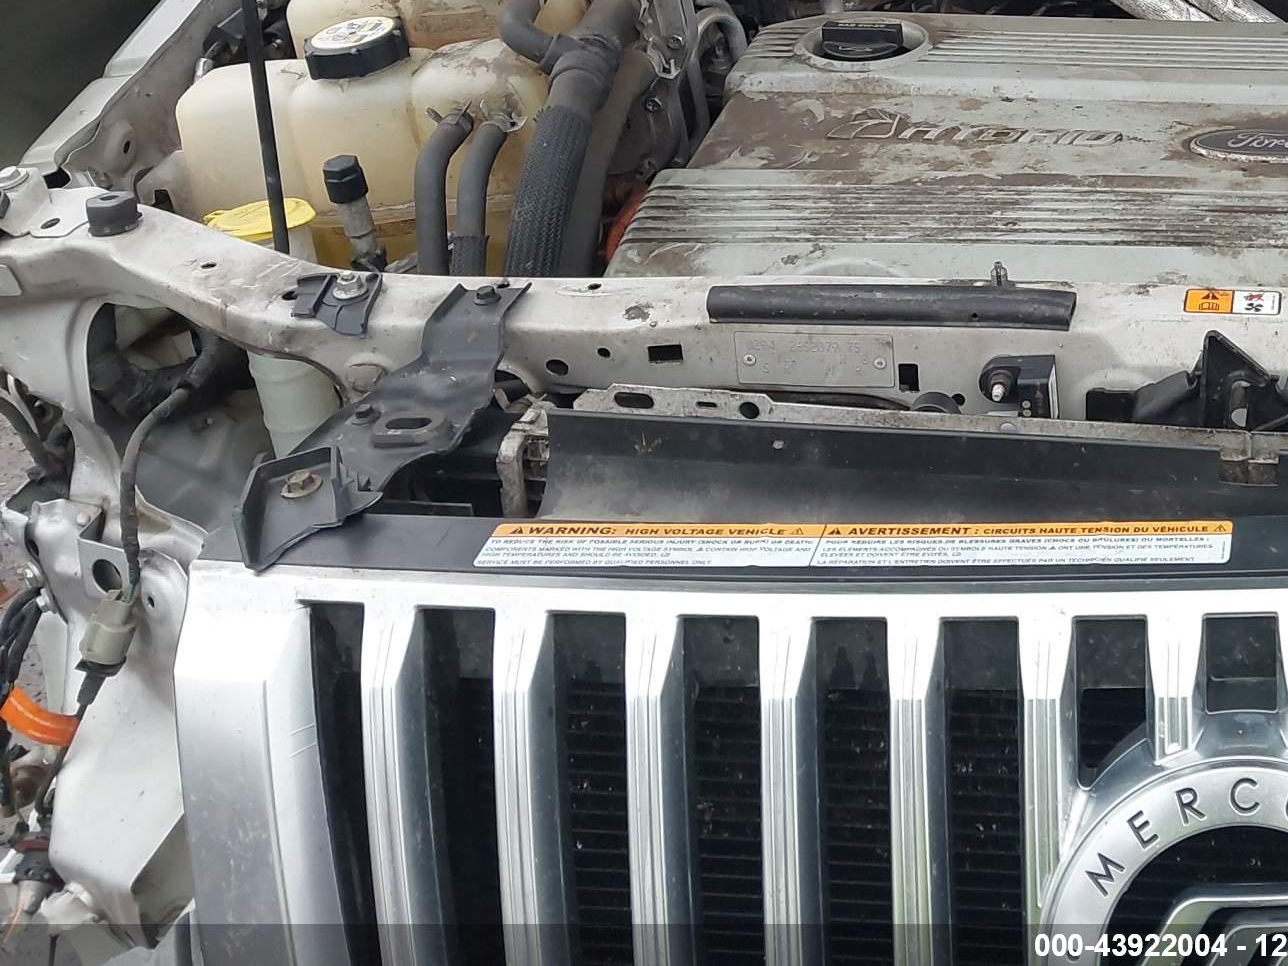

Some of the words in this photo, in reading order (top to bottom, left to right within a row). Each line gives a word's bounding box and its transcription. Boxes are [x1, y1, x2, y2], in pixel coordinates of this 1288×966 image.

[529, 526, 616, 535] WARNING:
[848, 527, 971, 535] AVERTISSEMENT
[983, 527, 1036, 535] CIRCUITS
[1082, 526, 1131, 534] TENSION
[1152, 524, 1208, 533] VÉHICULE
